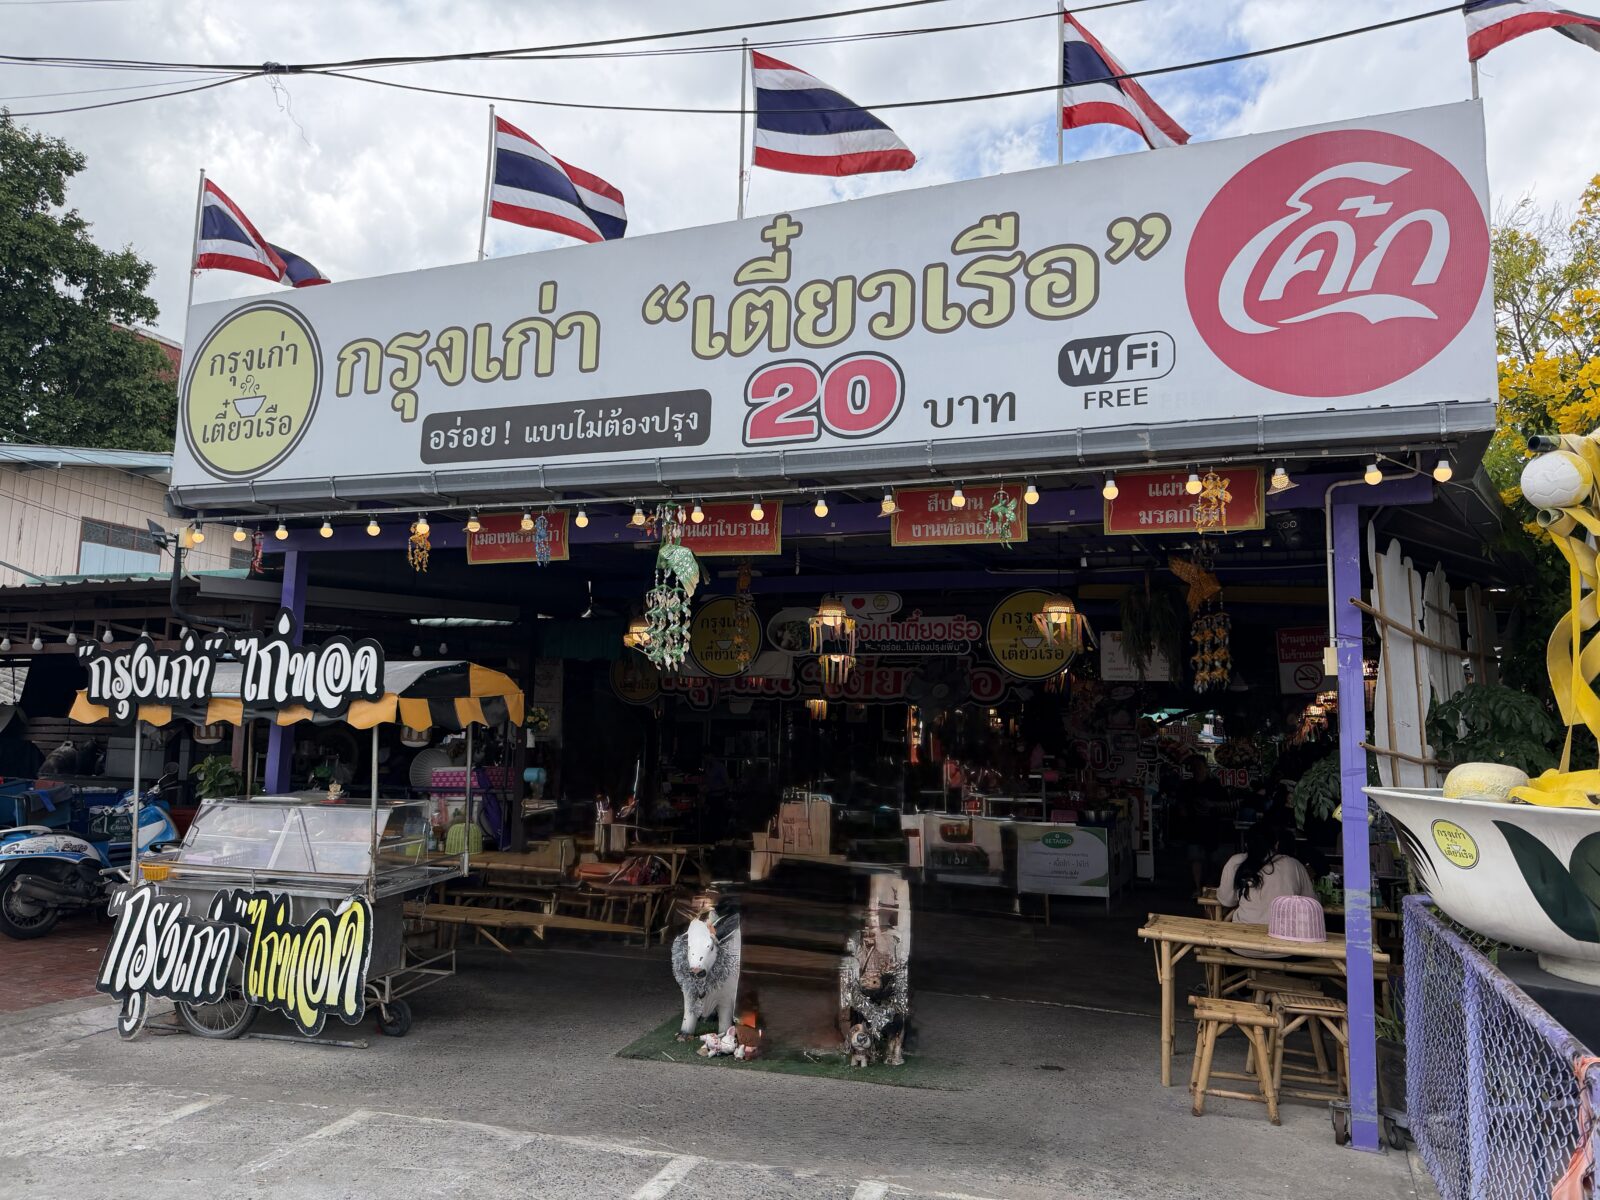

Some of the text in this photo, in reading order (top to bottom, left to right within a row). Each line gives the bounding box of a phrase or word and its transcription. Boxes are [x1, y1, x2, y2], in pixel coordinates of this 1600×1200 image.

[209, 331, 298, 387] กรุงเก่า
[336, 281, 601, 422] กรุงเก่า
[202, 400, 293, 444] เตี๋ยวเรือ
[743, 351, 1017, 447] 20 บาท
[1083, 387, 1149, 410] FREE
[524, 406, 699, 443] แบบไม่ต้องปรุง
[927, 492, 984, 512] สืบาน
[234, 612, 378, 708] ไก่ทอด
